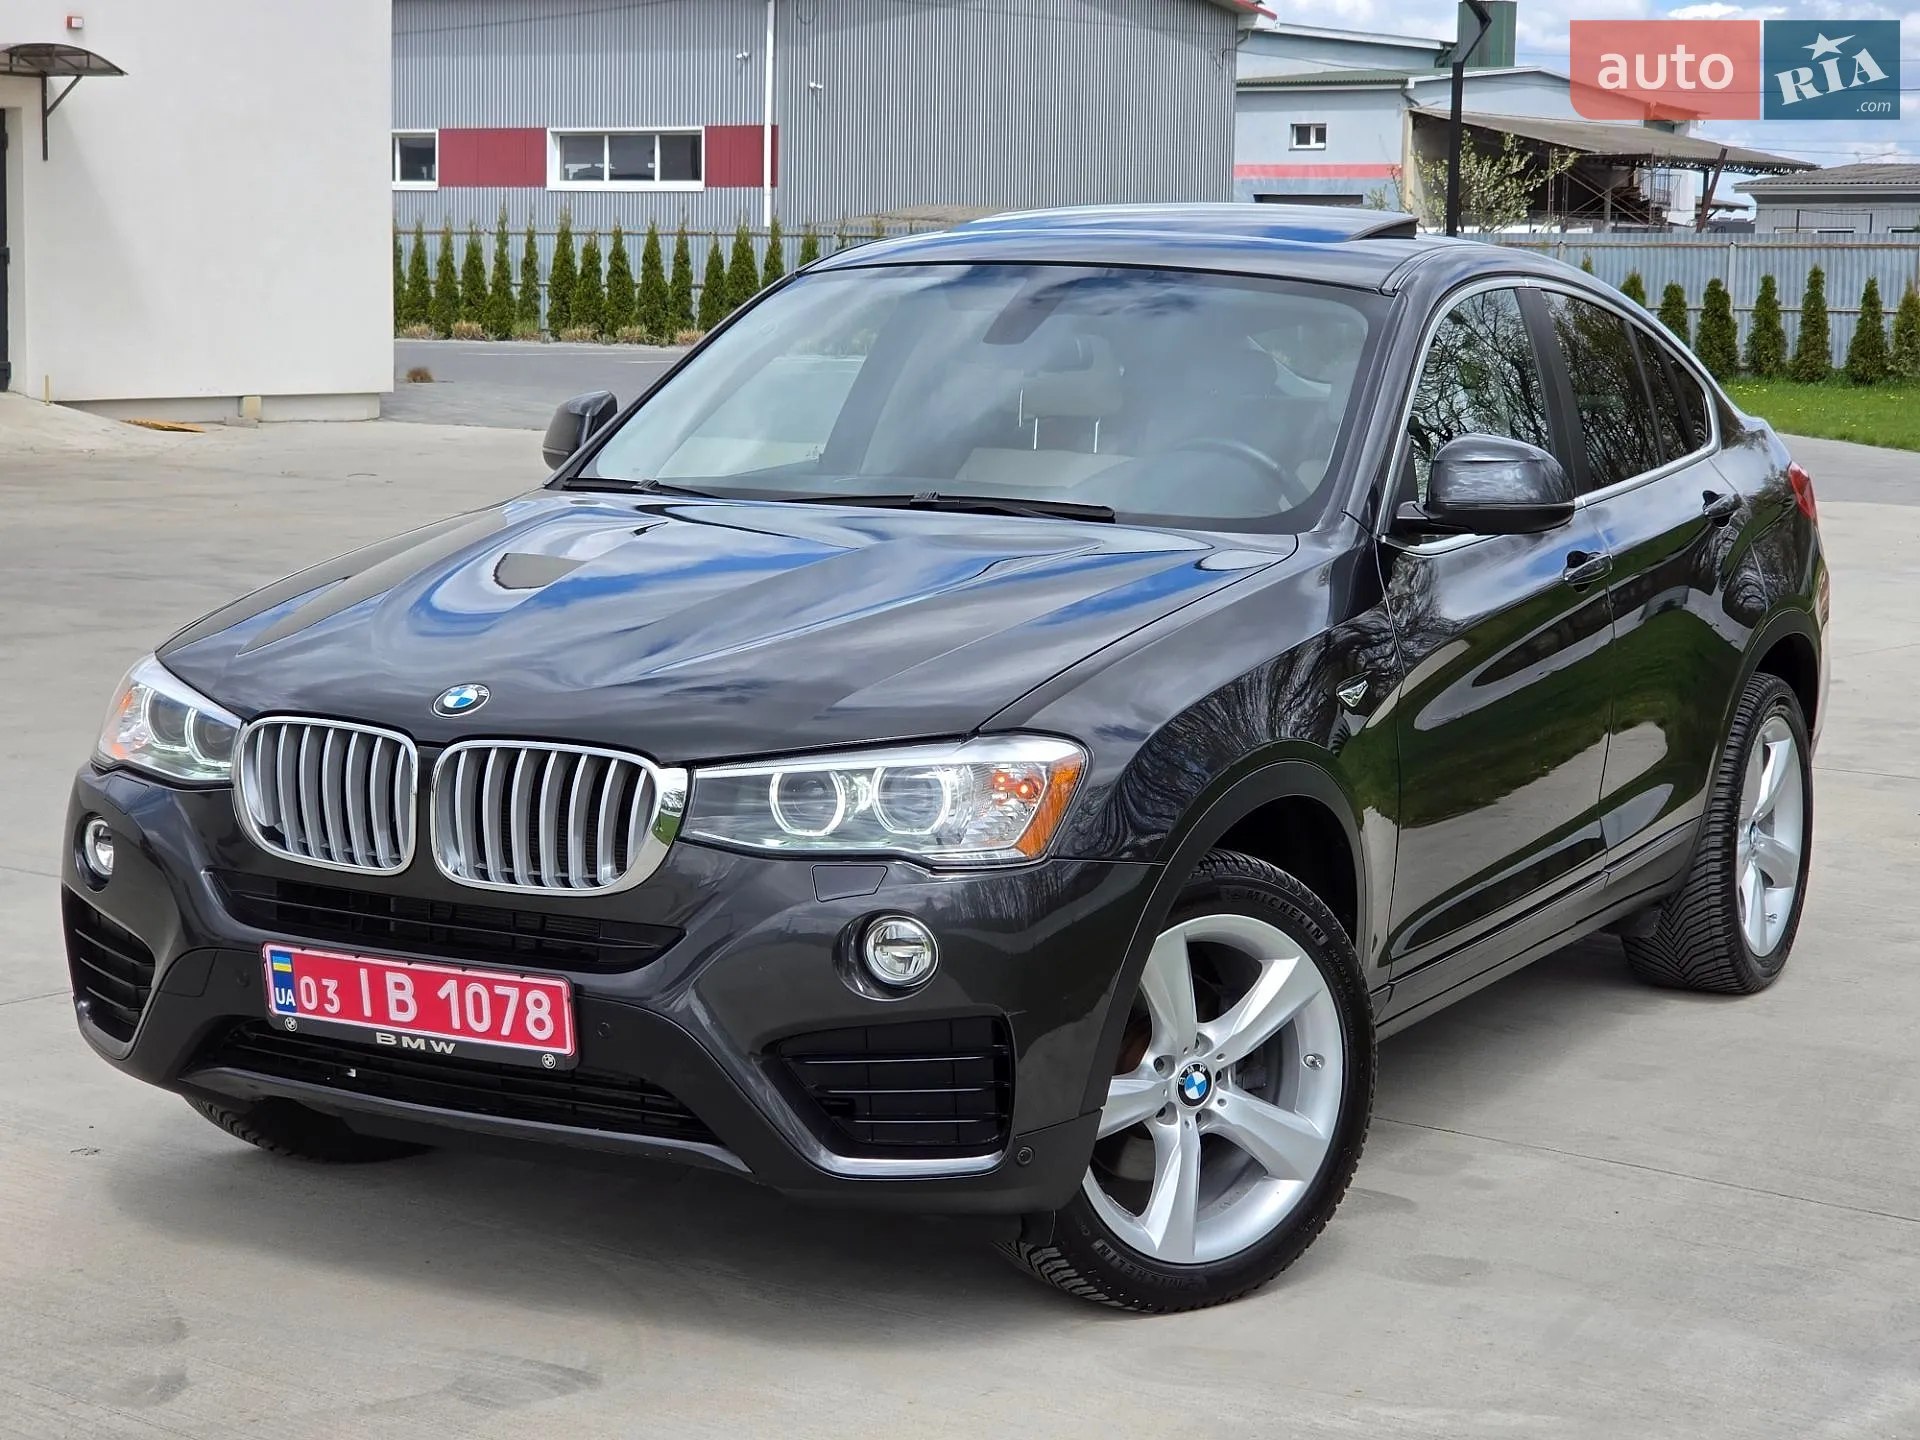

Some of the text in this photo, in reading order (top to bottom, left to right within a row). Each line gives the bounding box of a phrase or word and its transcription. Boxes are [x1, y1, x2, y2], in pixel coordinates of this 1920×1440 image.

[1247, 888, 1325, 941] MICHELIN
[275, 986, 297, 1007] UA
[300, 975, 341, 1014] 03
[436, 978, 555, 1041] 1078
[375, 1032, 456, 1055] BMW
